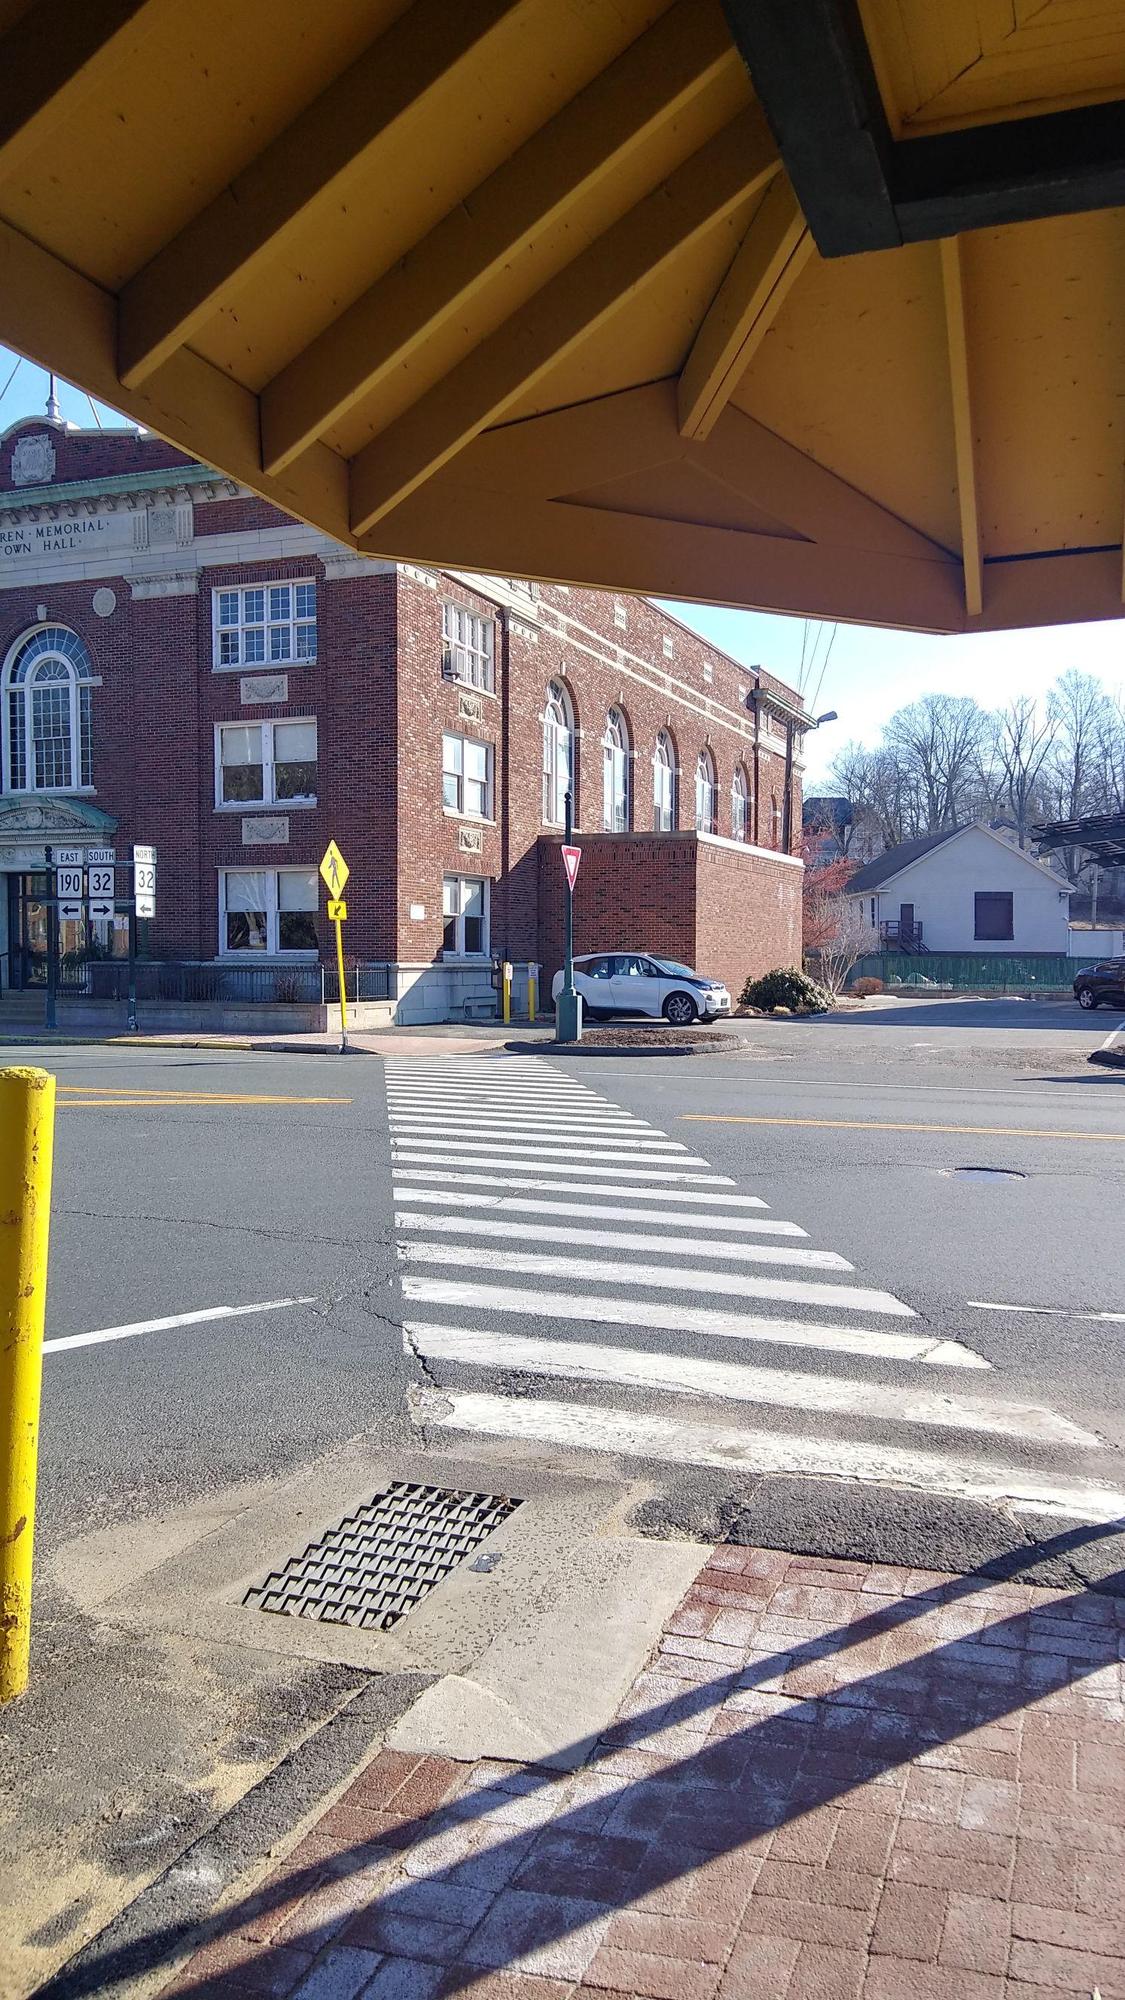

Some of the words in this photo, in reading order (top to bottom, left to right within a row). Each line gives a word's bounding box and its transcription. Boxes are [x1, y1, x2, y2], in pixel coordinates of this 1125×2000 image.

[36, 520, 104, 539] MEMORIAL
[0, 543, 31, 556] OWN
[43, 538, 76, 551] HALL
[60, 852, 79, 862] EAST
[88, 851, 114, 861] SOUTH
[135, 849, 155, 860] NORTH
[60, 874, 80, 892] 190
[92, 873, 111, 891] 32
[138, 870, 154, 889] 32
